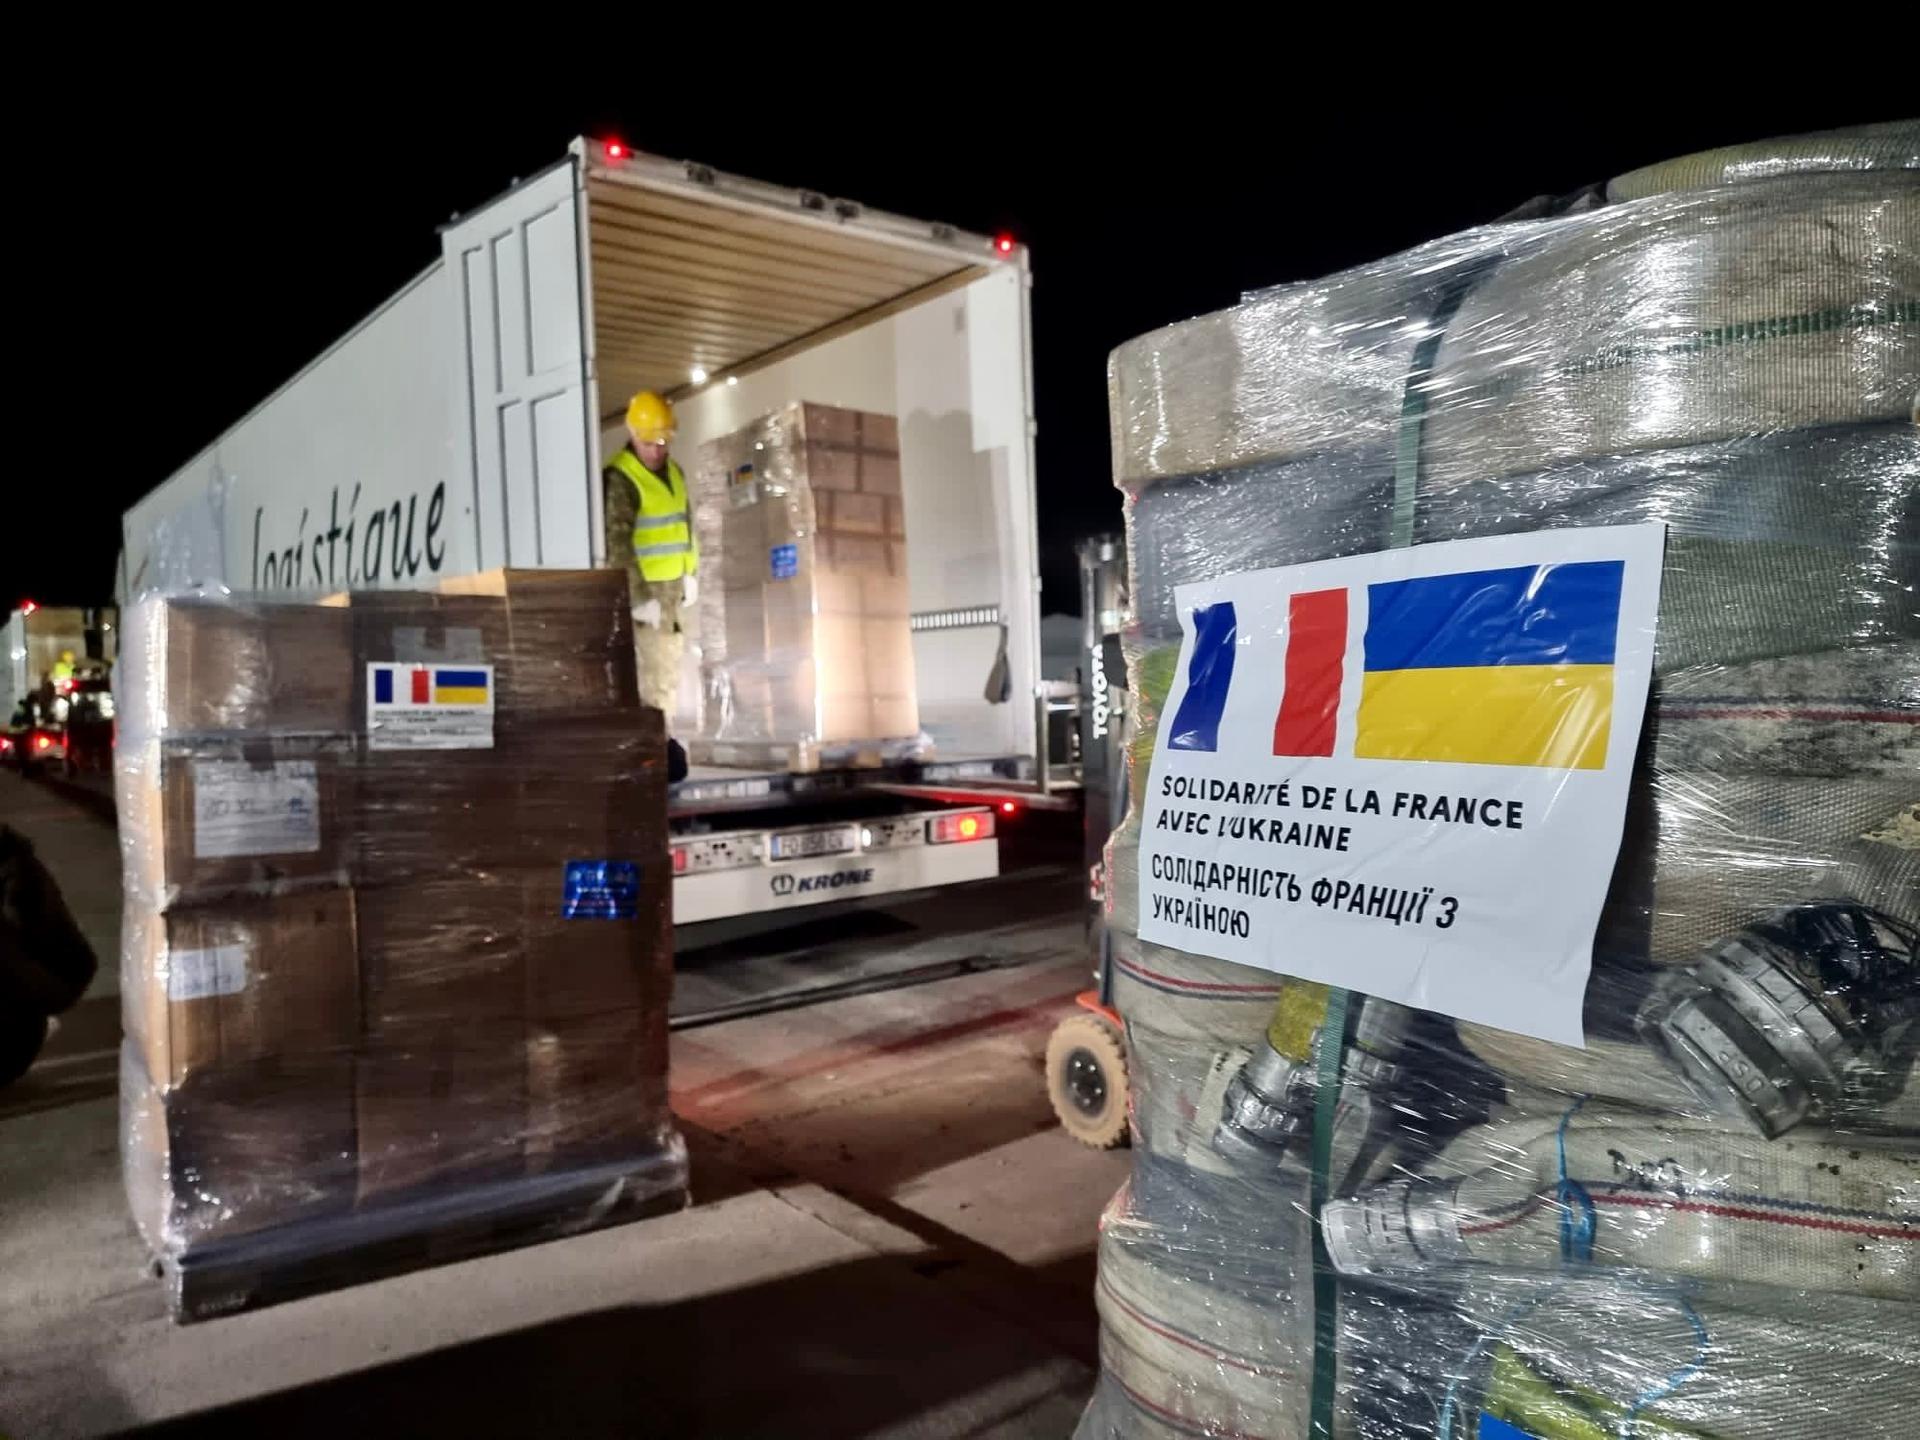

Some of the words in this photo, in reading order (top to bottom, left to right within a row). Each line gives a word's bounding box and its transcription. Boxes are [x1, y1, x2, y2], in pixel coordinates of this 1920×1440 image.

[1091, 643, 1108, 740] TOYOTA
[1156, 808, 1211, 836] AVEC
[1161, 775, 1291, 807] SOLIDARITÉ
[1301, 785, 1337, 812] DE
[1345, 788, 1381, 815] LA
[1391, 792, 1524, 830] FRANCE
[799, 867, 876, 893] KRONE
[1151, 853, 1301, 902] СОЛІДАРНІСТЬ
[1311, 877, 1435, 926] ФРАНЦІЇ
[1152, 893, 1250, 939] УКРАЇНОЮ
